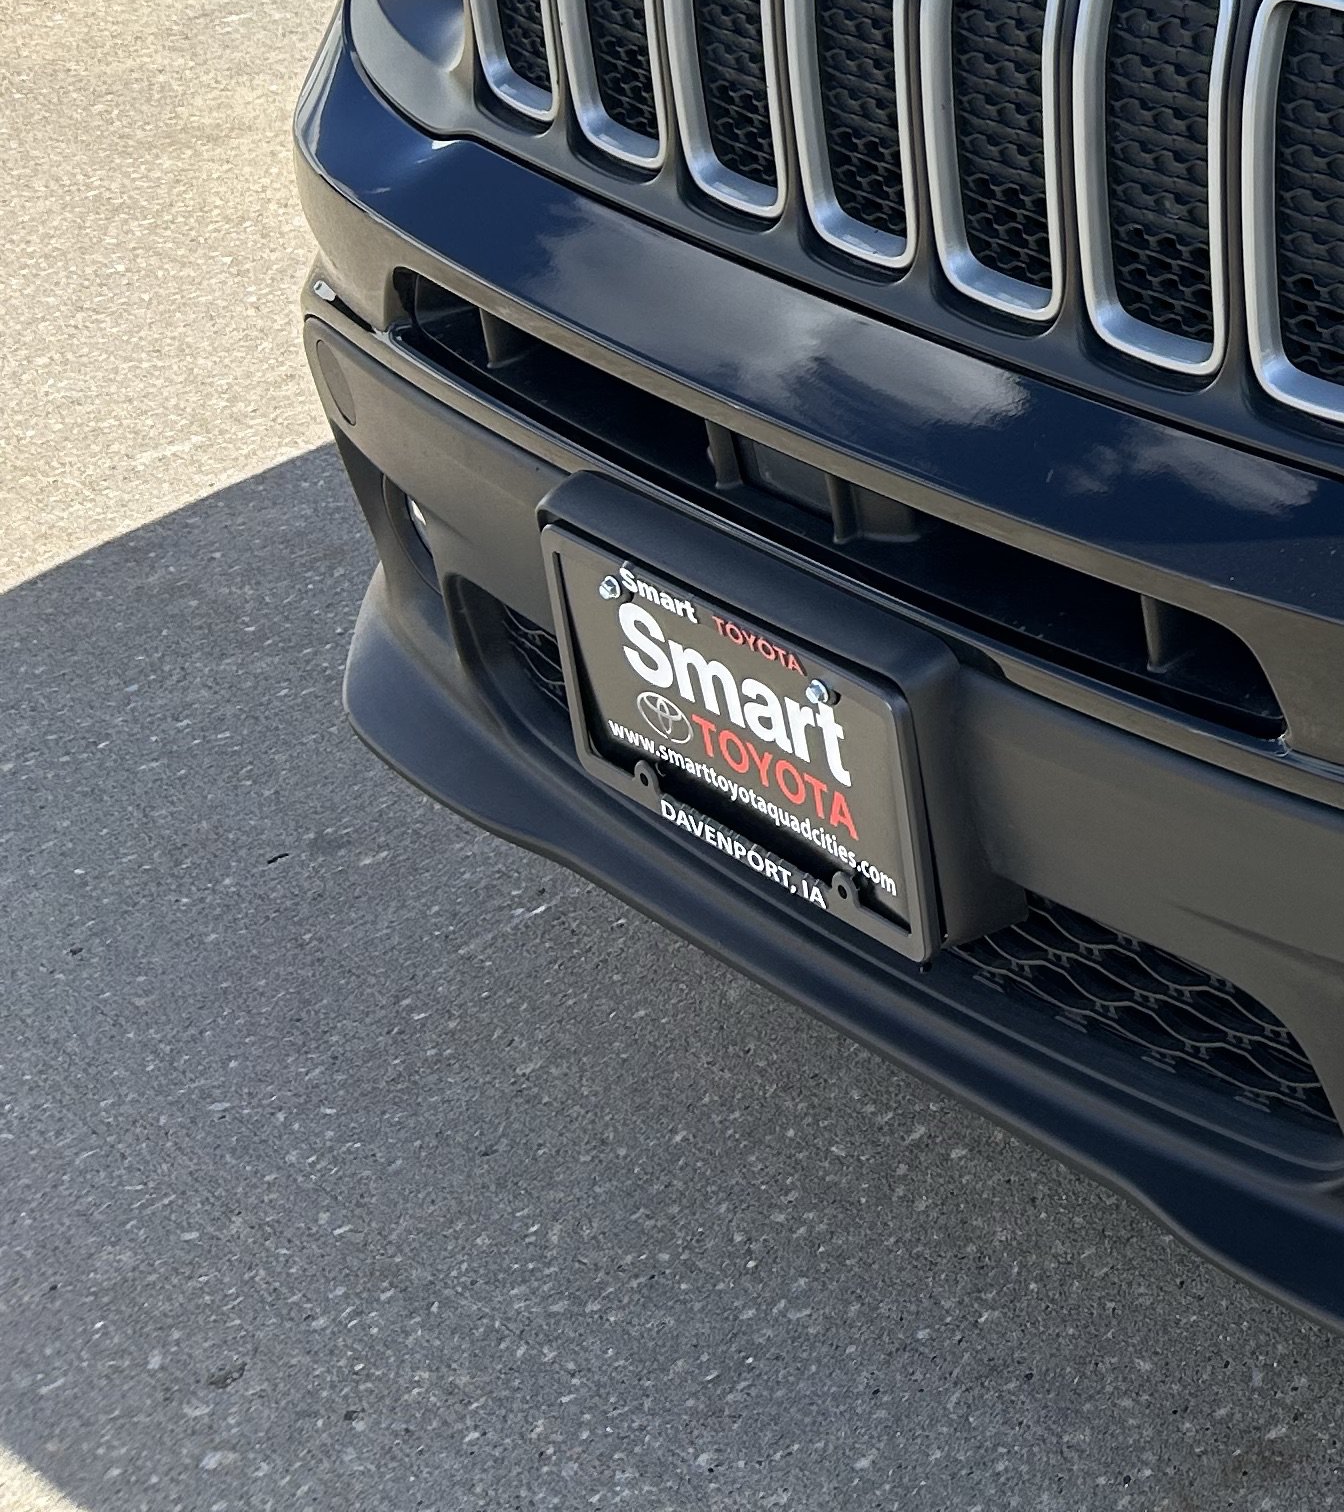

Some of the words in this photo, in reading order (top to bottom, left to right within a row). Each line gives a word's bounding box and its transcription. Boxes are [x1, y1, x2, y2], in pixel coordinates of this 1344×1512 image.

[619, 566, 699, 624] Smart
[712, 615, 806, 676] TOYOTA
[619, 602, 852, 787] Smart
[608, 719, 897, 896] www.smarttoyotaquadcities.com
[692, 713, 859, 841] TOYOTA
[661, 799, 797, 894] DAVENPORT,
[802, 879, 828, 910] IA
